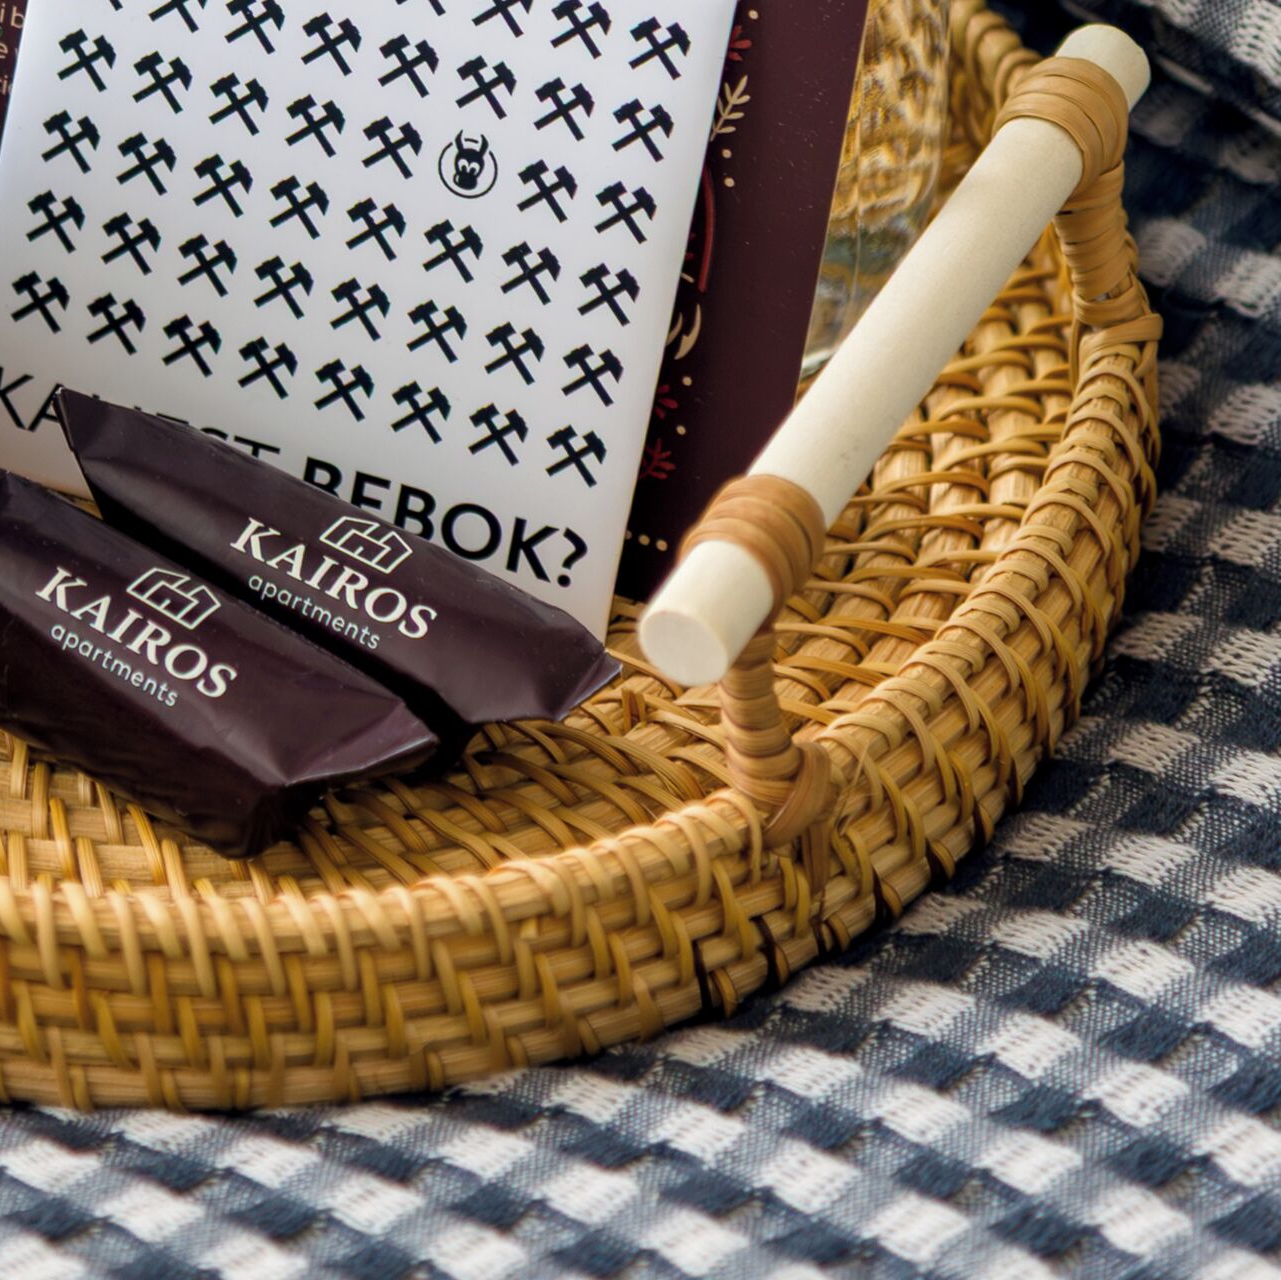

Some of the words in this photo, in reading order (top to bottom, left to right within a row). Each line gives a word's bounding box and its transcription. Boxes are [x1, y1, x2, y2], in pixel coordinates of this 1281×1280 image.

[230, 517, 438, 640] KAIROS
[303, 456, 588, 588] BEBOK?
[35, 566, 238, 701] KAIROS
[50, 623, 180, 708] apartments
[248, 574, 382, 651] apartments
